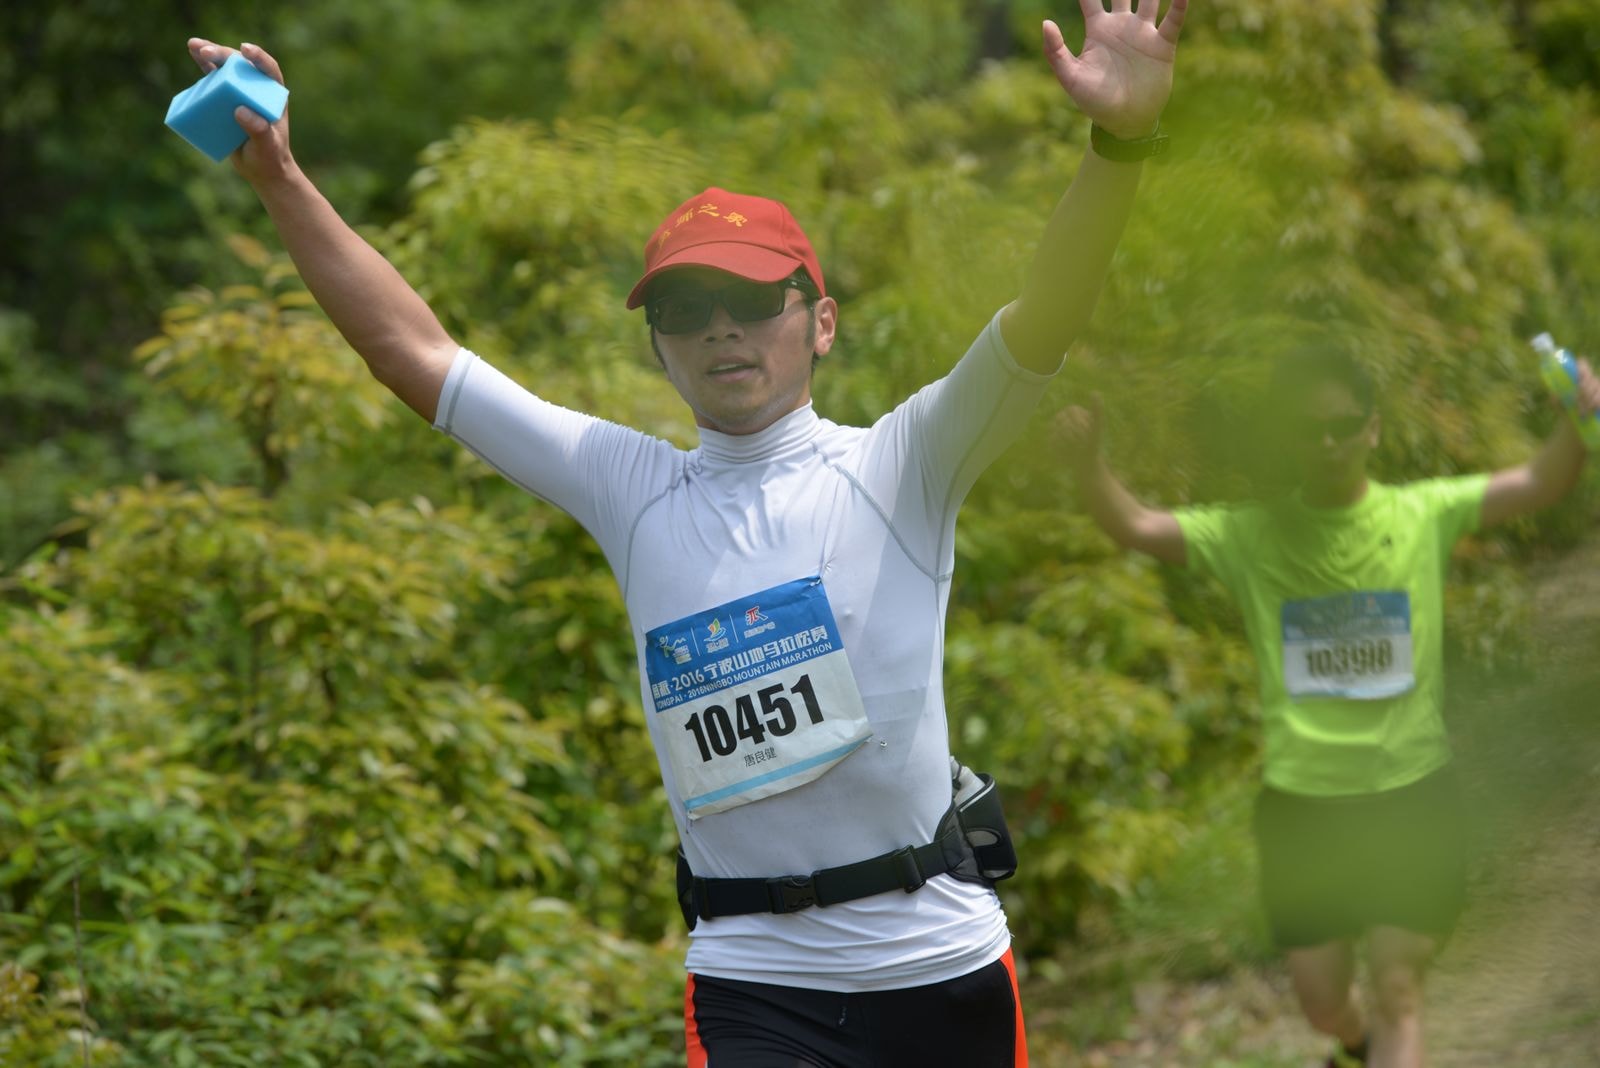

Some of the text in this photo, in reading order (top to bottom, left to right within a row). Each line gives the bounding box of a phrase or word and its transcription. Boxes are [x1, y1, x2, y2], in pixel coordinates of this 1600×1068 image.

[704, 627, 829, 680] 宁波山地马拉松赛
[733, 658, 781, 682] MOUNTAIN
[782, 641, 833, 666] MARATHON
[684, 673, 825, 763] 10451
[743, 746, 777, 767] 唐良健
